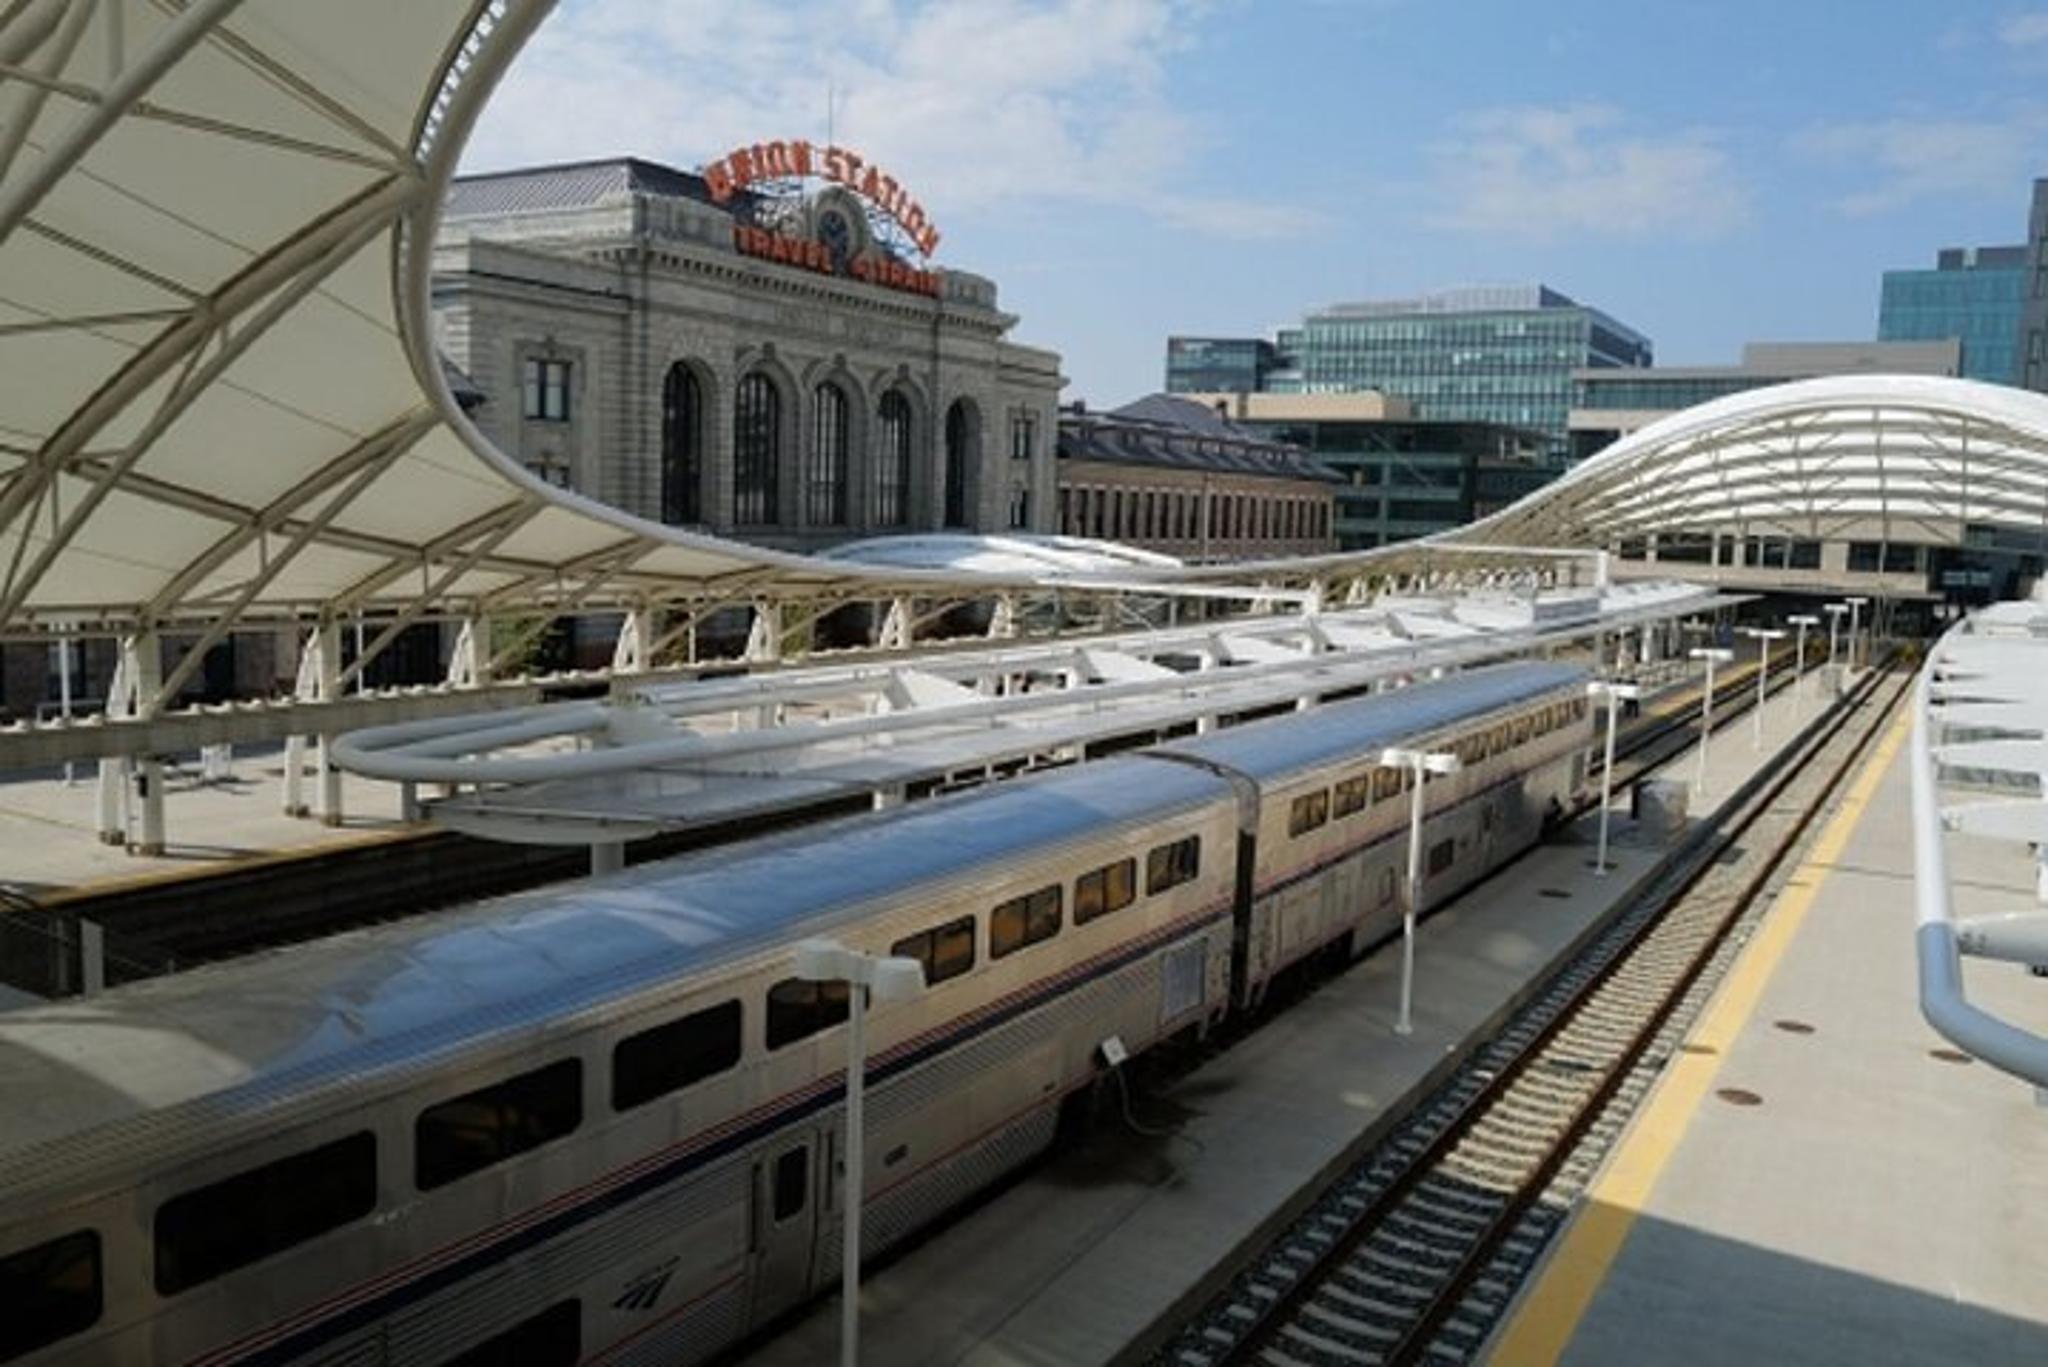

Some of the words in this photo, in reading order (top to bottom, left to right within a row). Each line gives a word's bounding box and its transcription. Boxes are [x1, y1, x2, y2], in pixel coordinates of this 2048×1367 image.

[704, 140, 812, 204] UNION
[823, 145, 940, 259] STATION
[732, 227, 833, 274] TRAVEL
[873, 259, 941, 299] TRAIN
